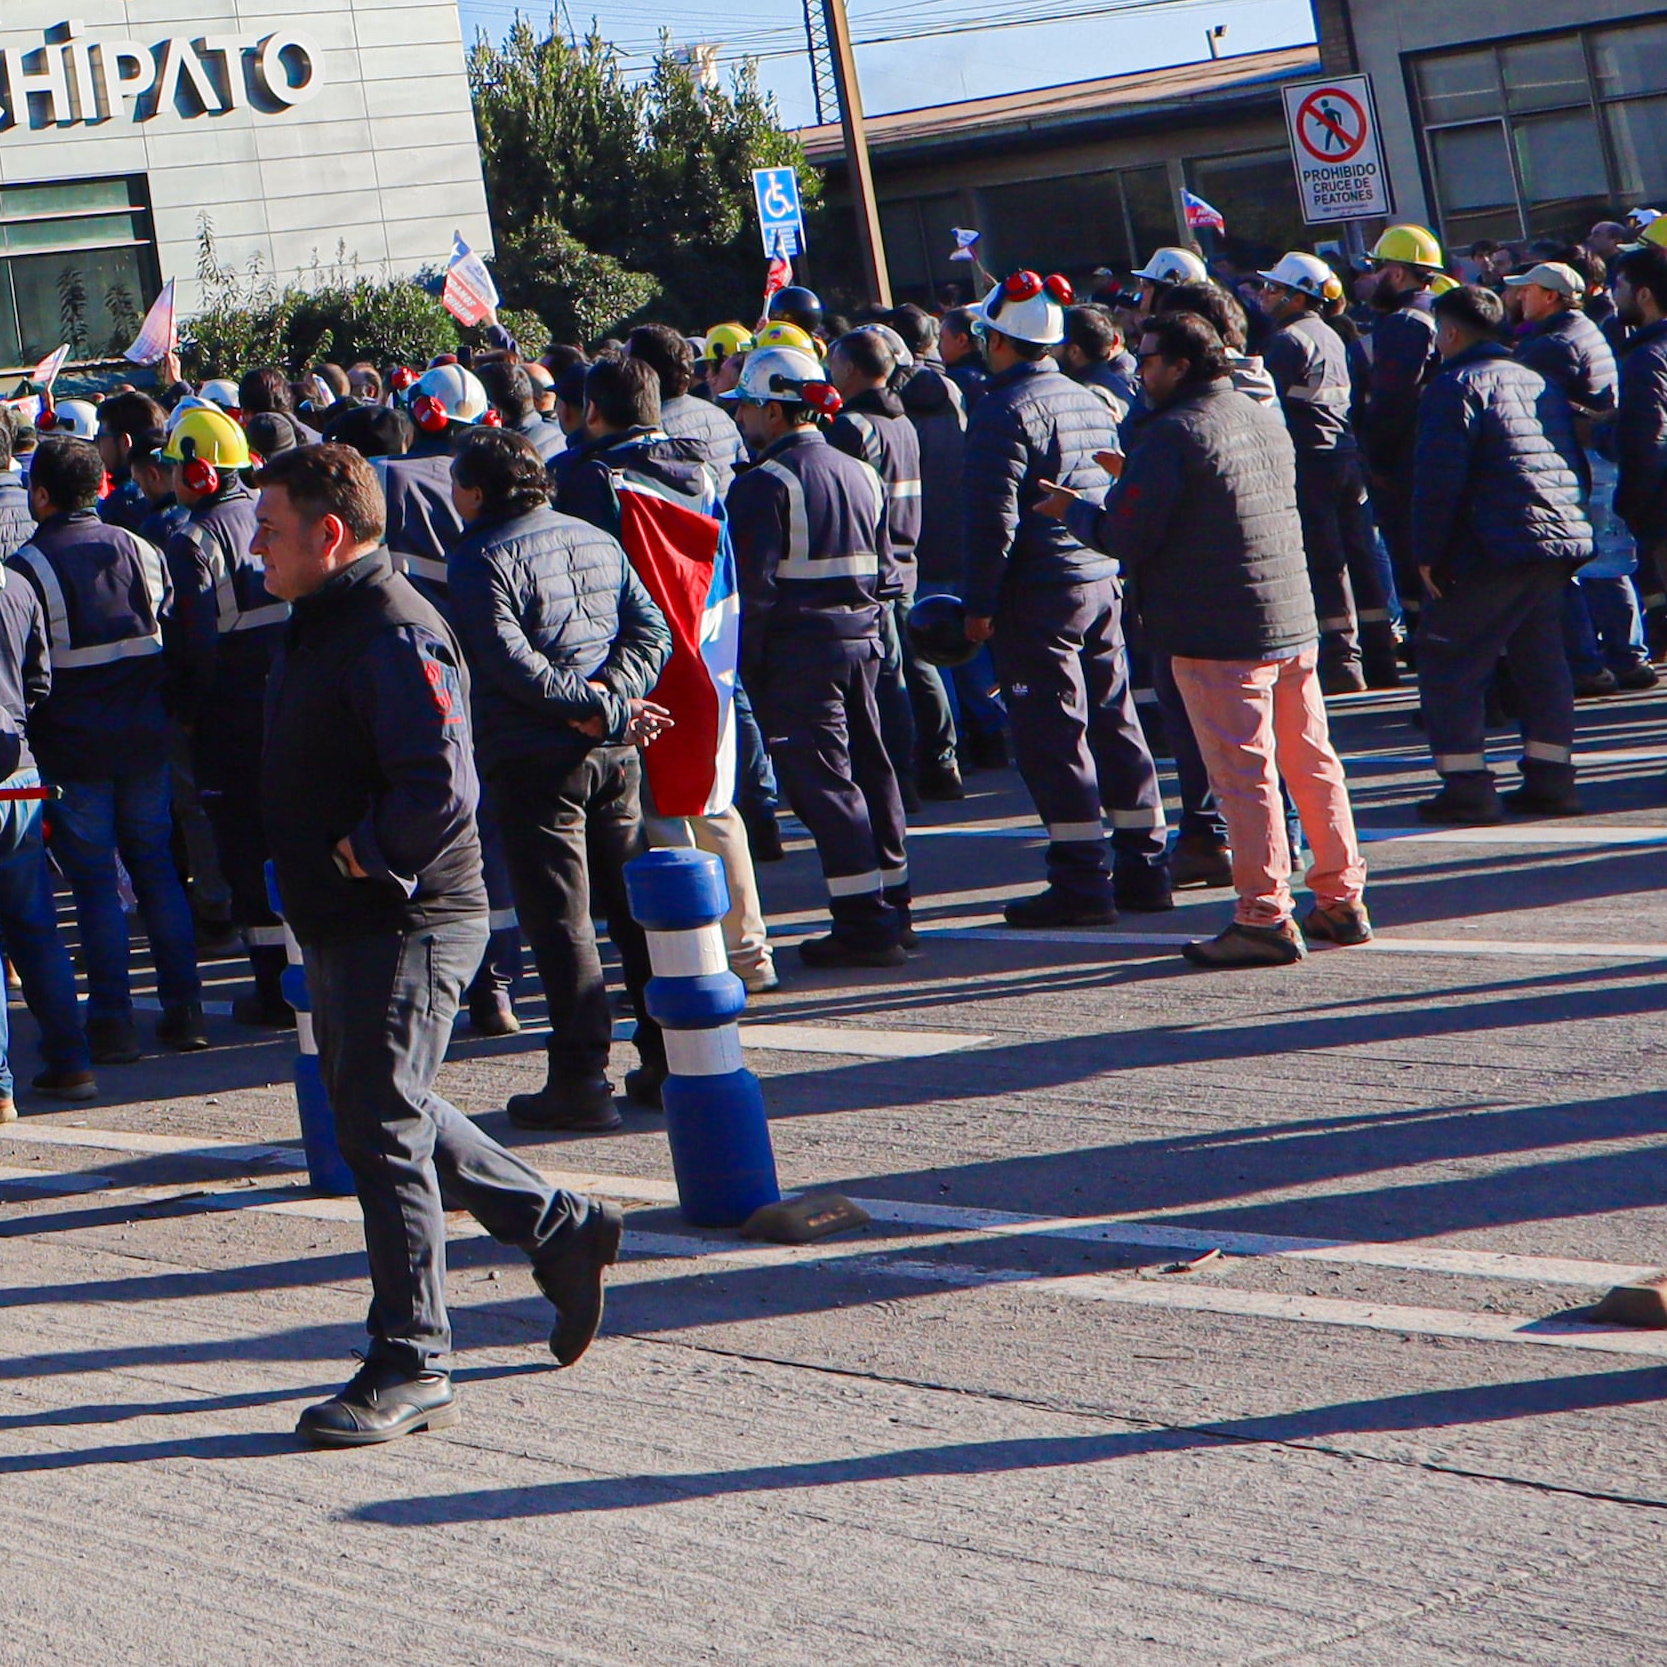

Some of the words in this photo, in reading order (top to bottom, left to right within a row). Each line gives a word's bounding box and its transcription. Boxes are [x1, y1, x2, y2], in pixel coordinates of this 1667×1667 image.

[1303, 163, 1376, 182] PROHIBIDO
[1313, 179, 1353, 193] CRUCE
[1354, 177, 1371, 189] DE
[1314, 189, 1373, 206] PEATONES
